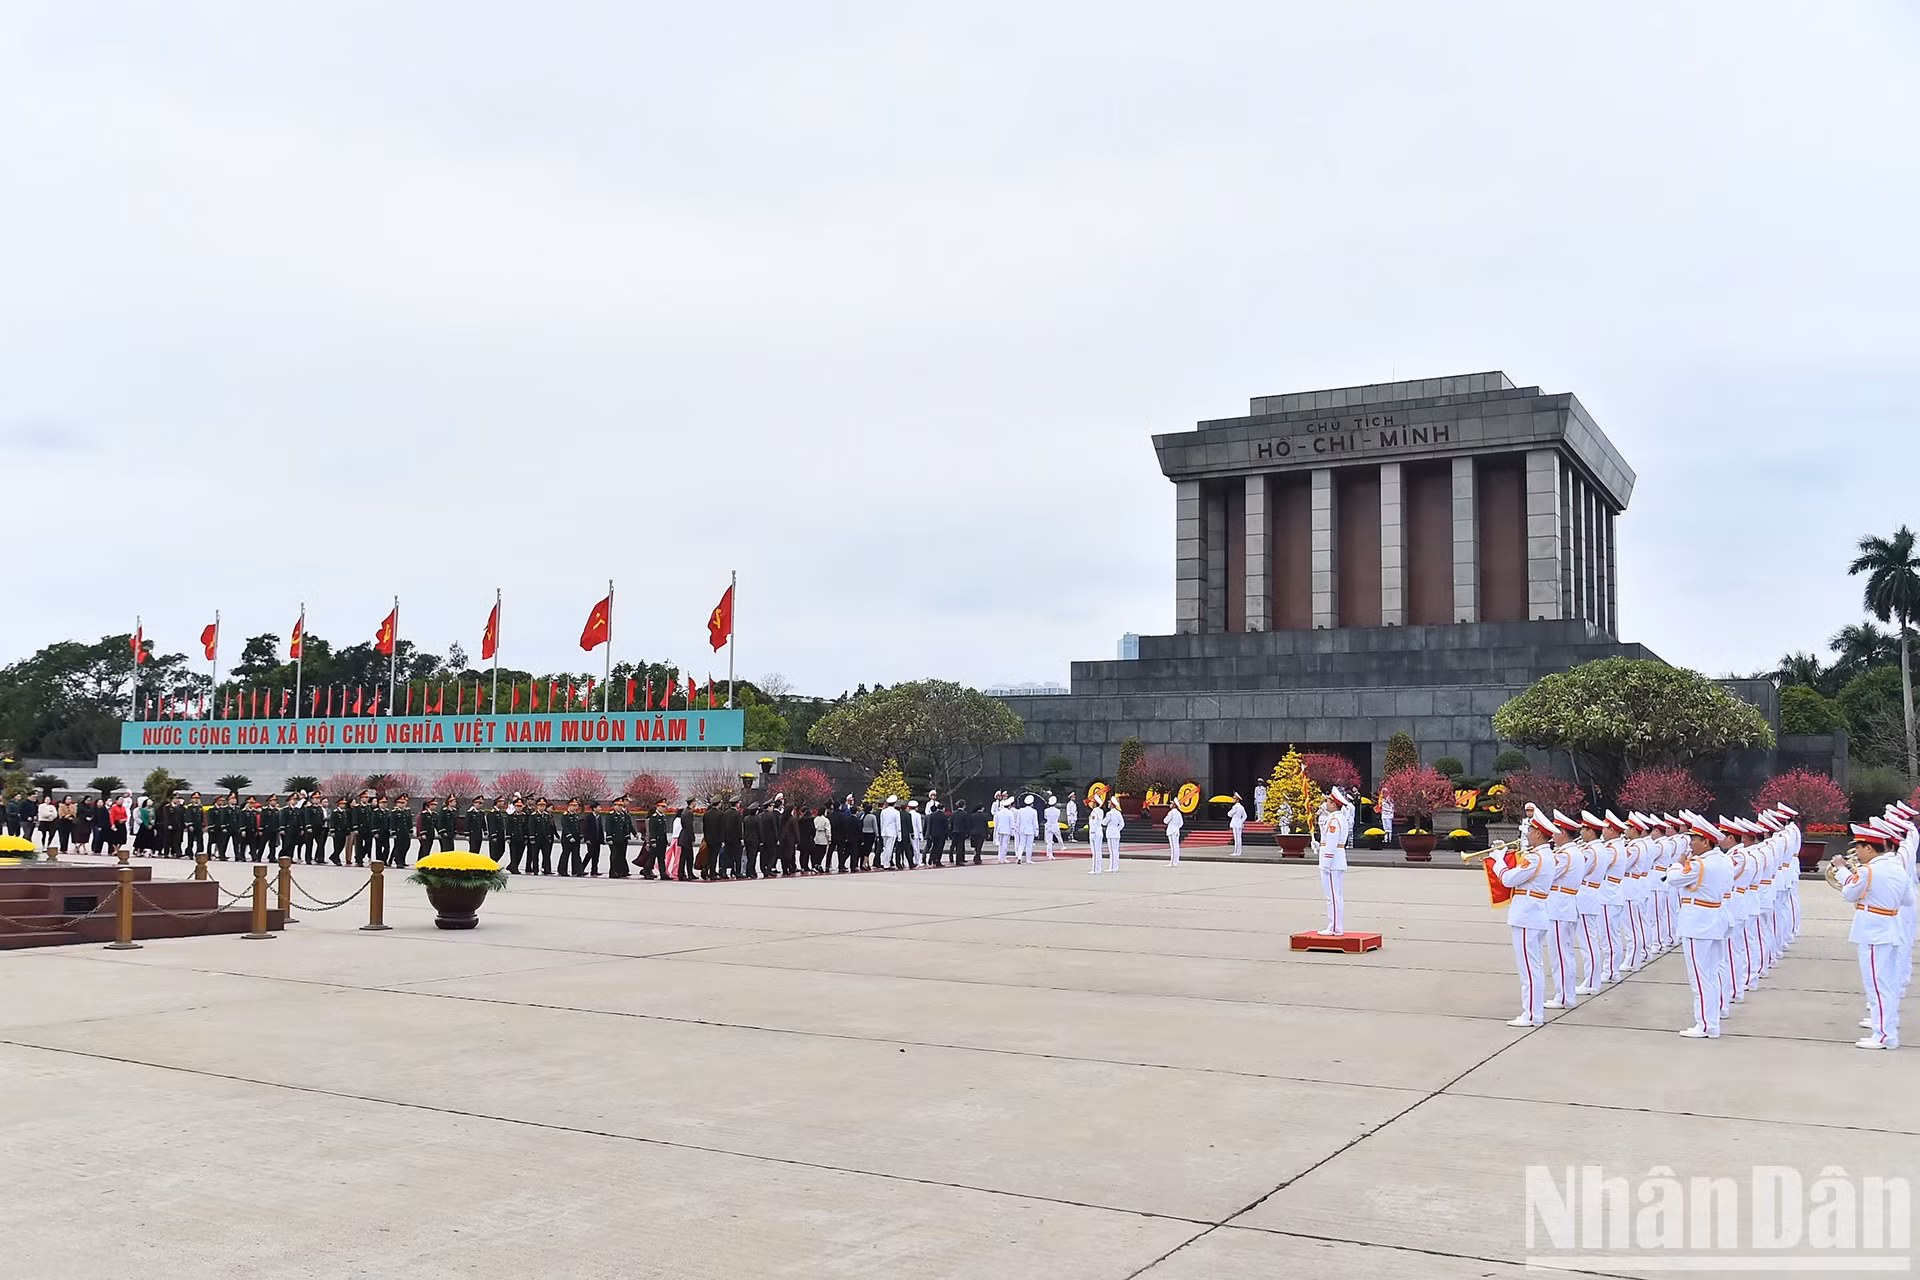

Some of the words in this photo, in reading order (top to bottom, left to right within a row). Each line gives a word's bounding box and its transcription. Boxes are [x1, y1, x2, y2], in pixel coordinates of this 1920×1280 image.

[1306, 417, 1340, 433] CHỦ
[1257, 434, 1291, 458] HỒ
[1313, 429, 1356, 453] CHÍ
[143, 723, 182, 746] NƯỚC
[189, 723, 231, 748] CỘNG
[237, 722, 270, 745] HÒA
[276, 722, 298, 745] XÃ
[306, 720, 335, 747] HỘI
[342, 718, 378, 744] CHỦ
[386, 719, 444, 744] NGHĨA
[454, 718, 496, 746] VIỆT
[505, 720, 552, 743] NAM
[561, 716, 625, 742] MUÔN
[635, 714, 687, 742] NĂM
